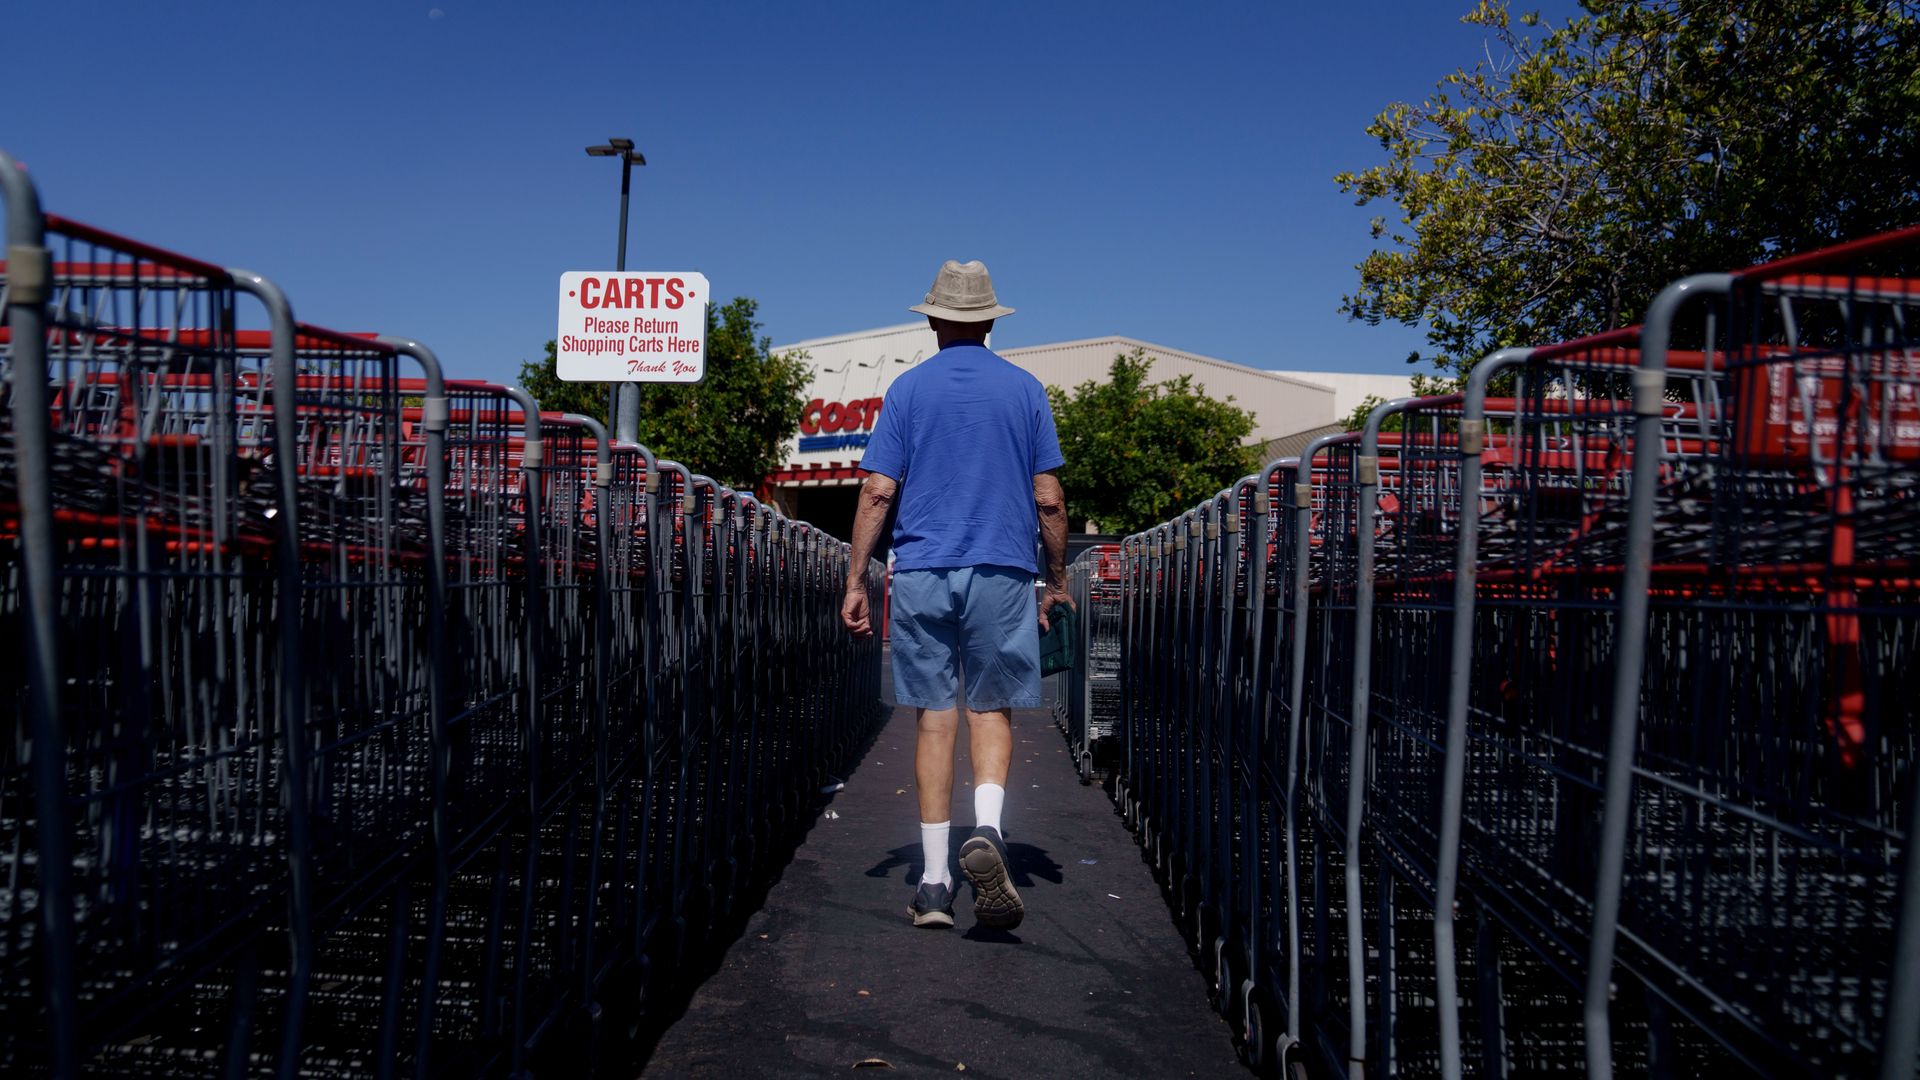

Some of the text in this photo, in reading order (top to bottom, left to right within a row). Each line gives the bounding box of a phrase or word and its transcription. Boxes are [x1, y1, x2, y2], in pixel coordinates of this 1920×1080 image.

[580, 277, 685, 310] CARTS
[584, 316, 678, 334] Please Return
[562, 335, 699, 356] Shopping Carts Here
[627, 359, 697, 376] Thank You
[800, 397, 883, 436] COST
